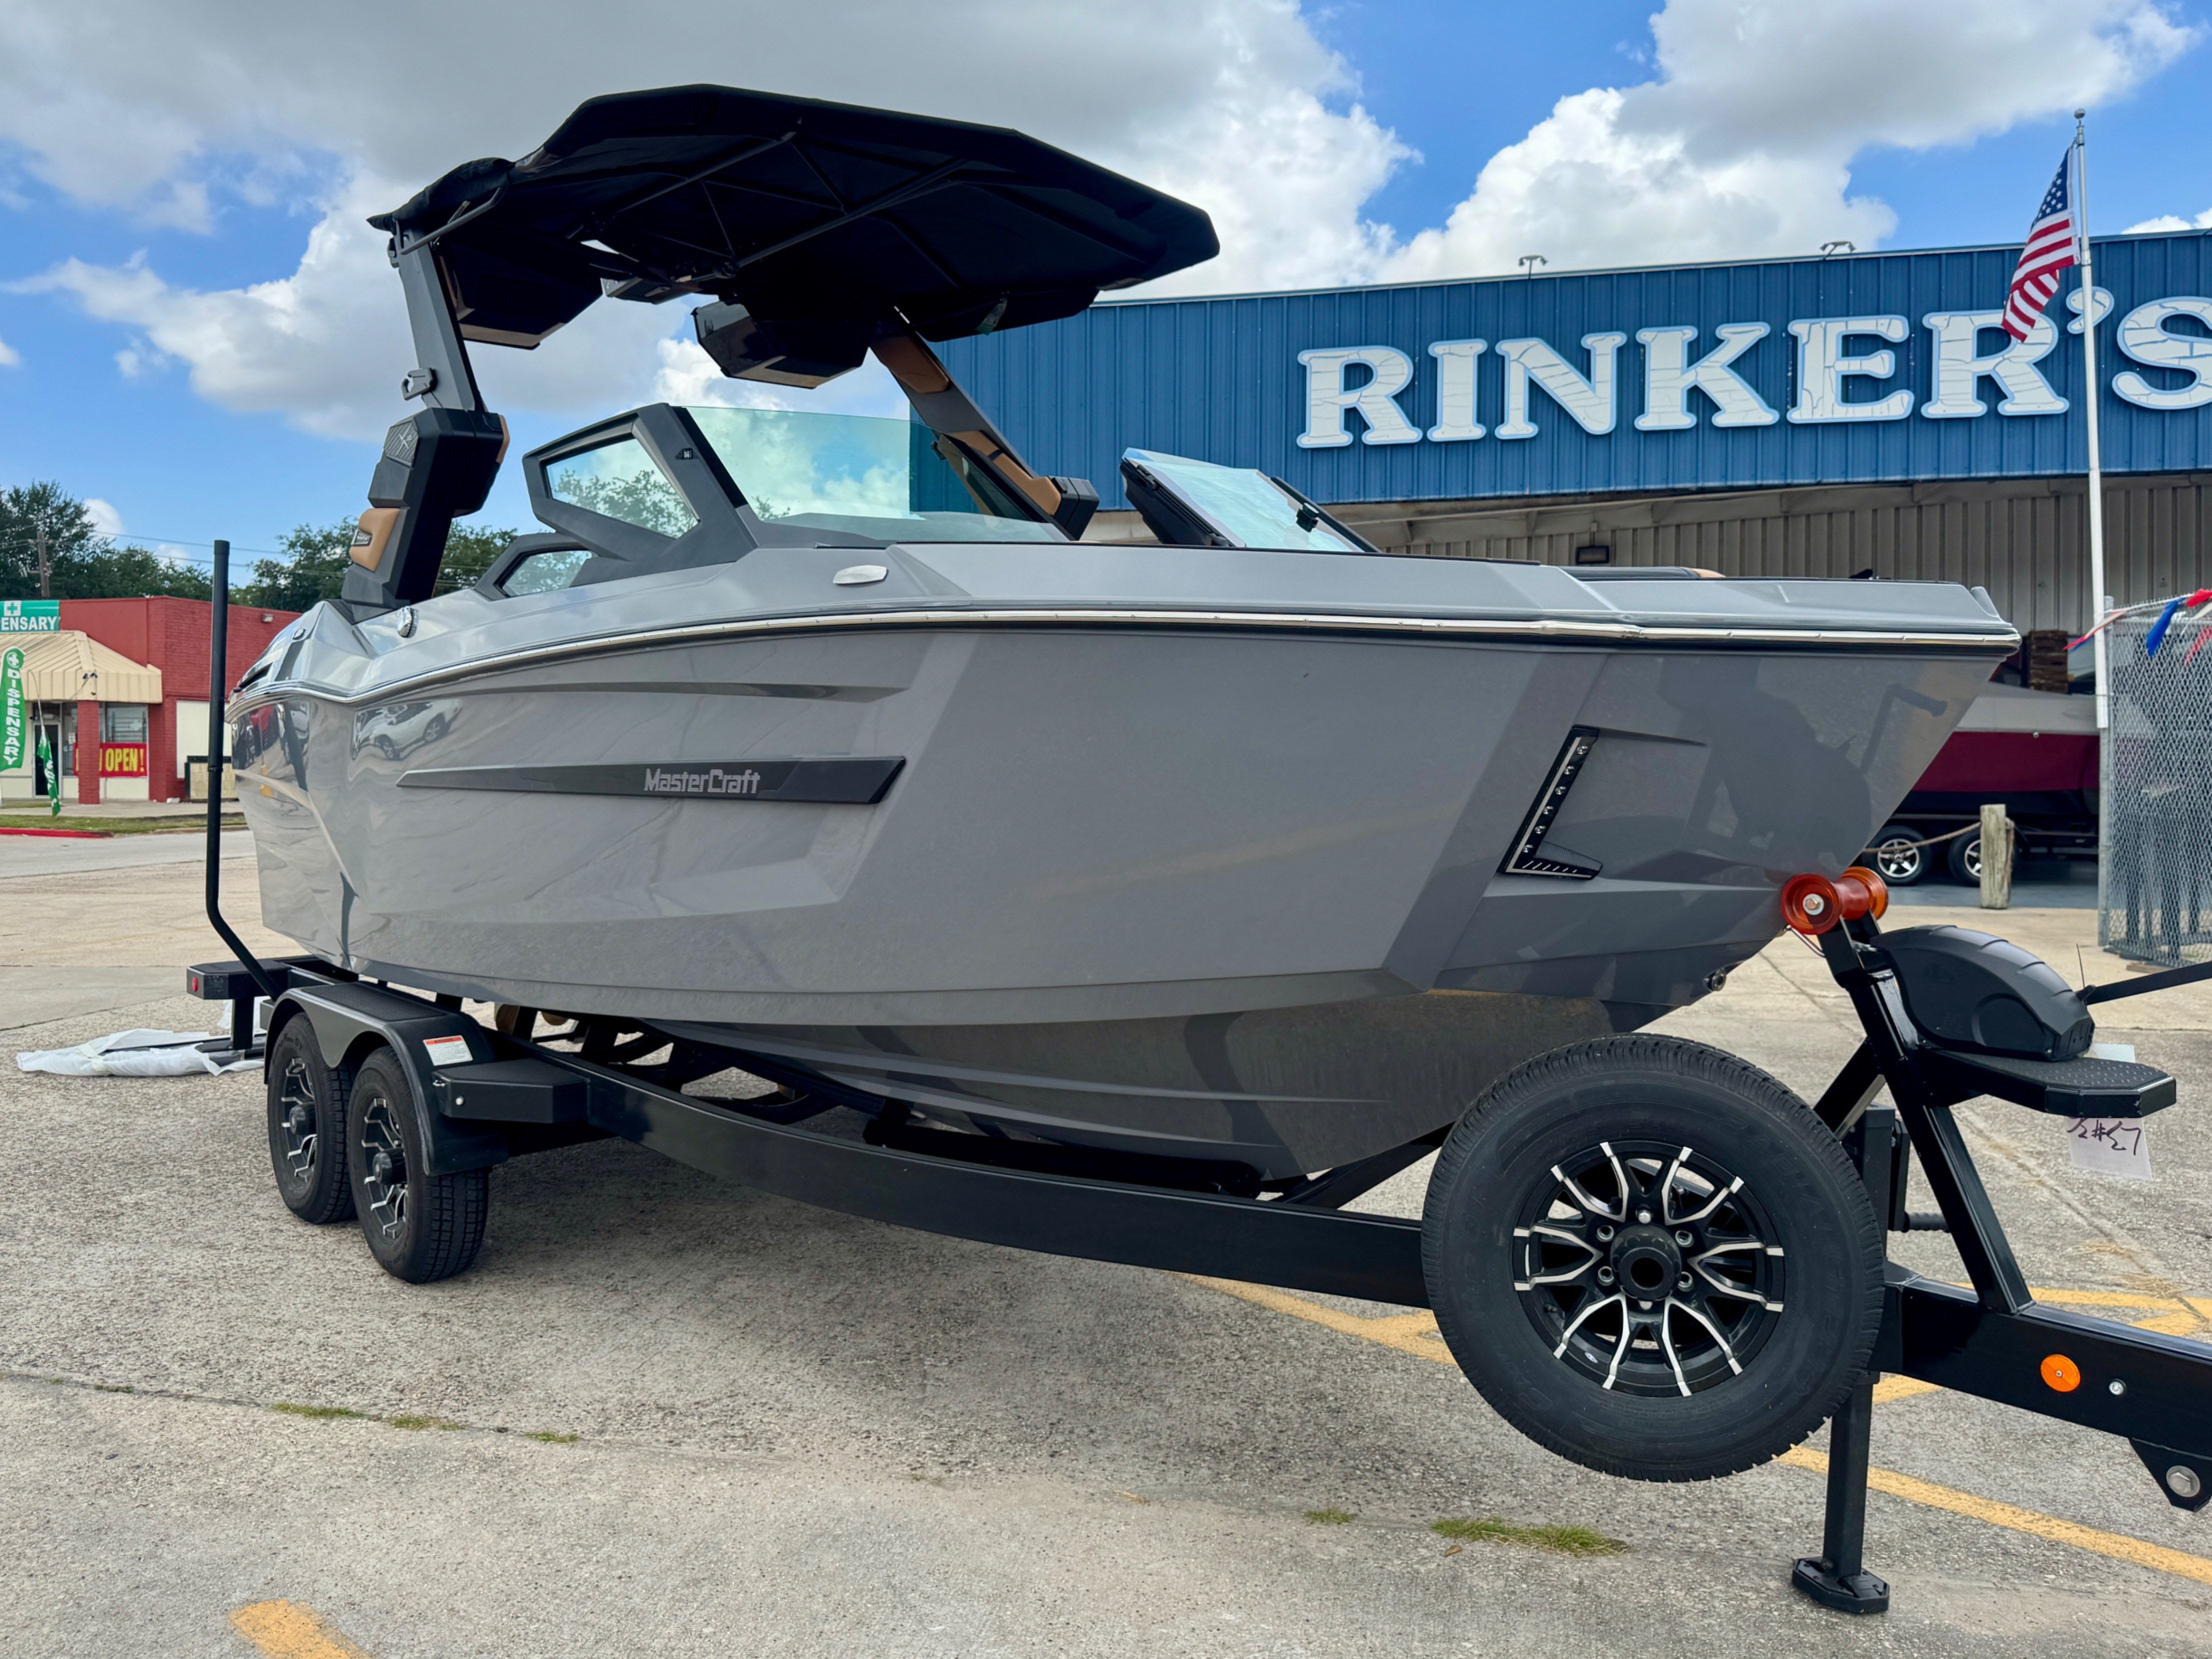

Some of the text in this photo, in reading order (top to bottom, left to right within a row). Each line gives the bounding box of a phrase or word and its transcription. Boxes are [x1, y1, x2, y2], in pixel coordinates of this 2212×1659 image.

[0, 616, 58, 630] ENSARY
[2, 668, 20, 766] DISPENSARY
[106, 748, 144, 772] OPEN!
[644, 768, 760, 794] MasterCraft
